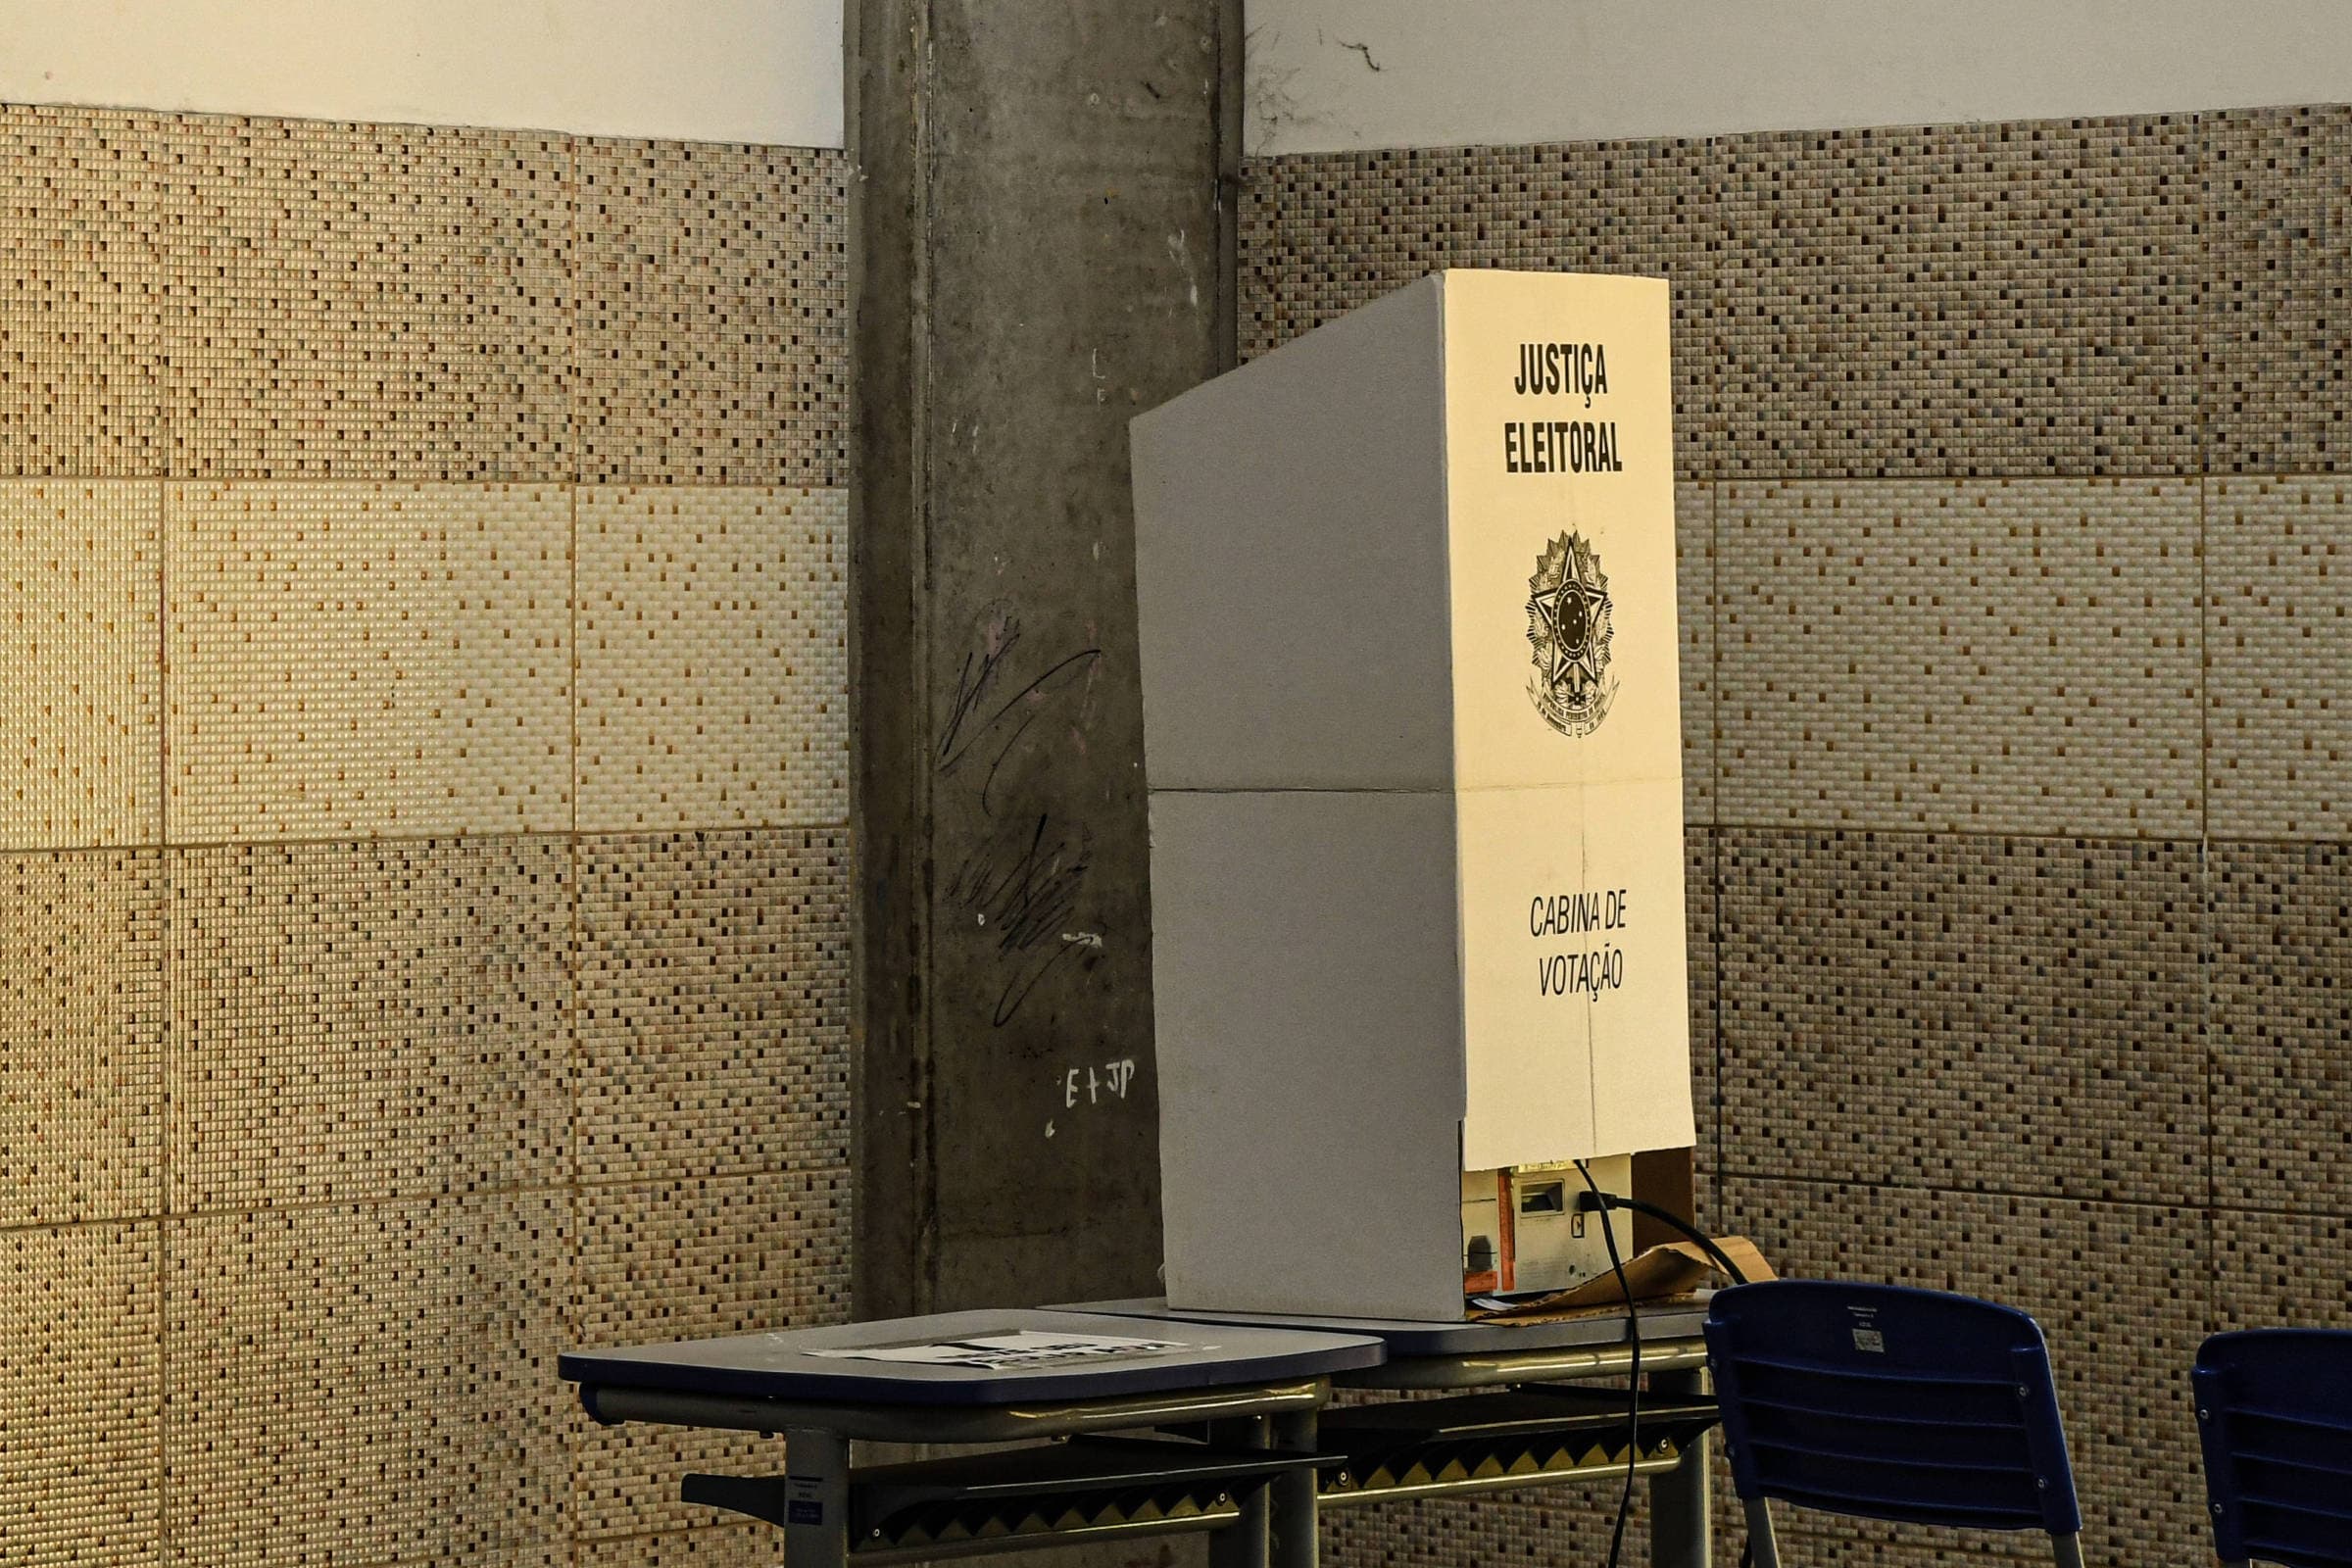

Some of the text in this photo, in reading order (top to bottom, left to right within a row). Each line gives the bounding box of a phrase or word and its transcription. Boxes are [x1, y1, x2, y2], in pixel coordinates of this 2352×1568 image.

[1514, 342, 1608, 410] JUSTIÇA
[1504, 420, 1623, 474] ELEITORAL
[1530, 889, 1627, 938] CABINA DE
[1539, 942, 1623, 1003] VOTAÇÃO
